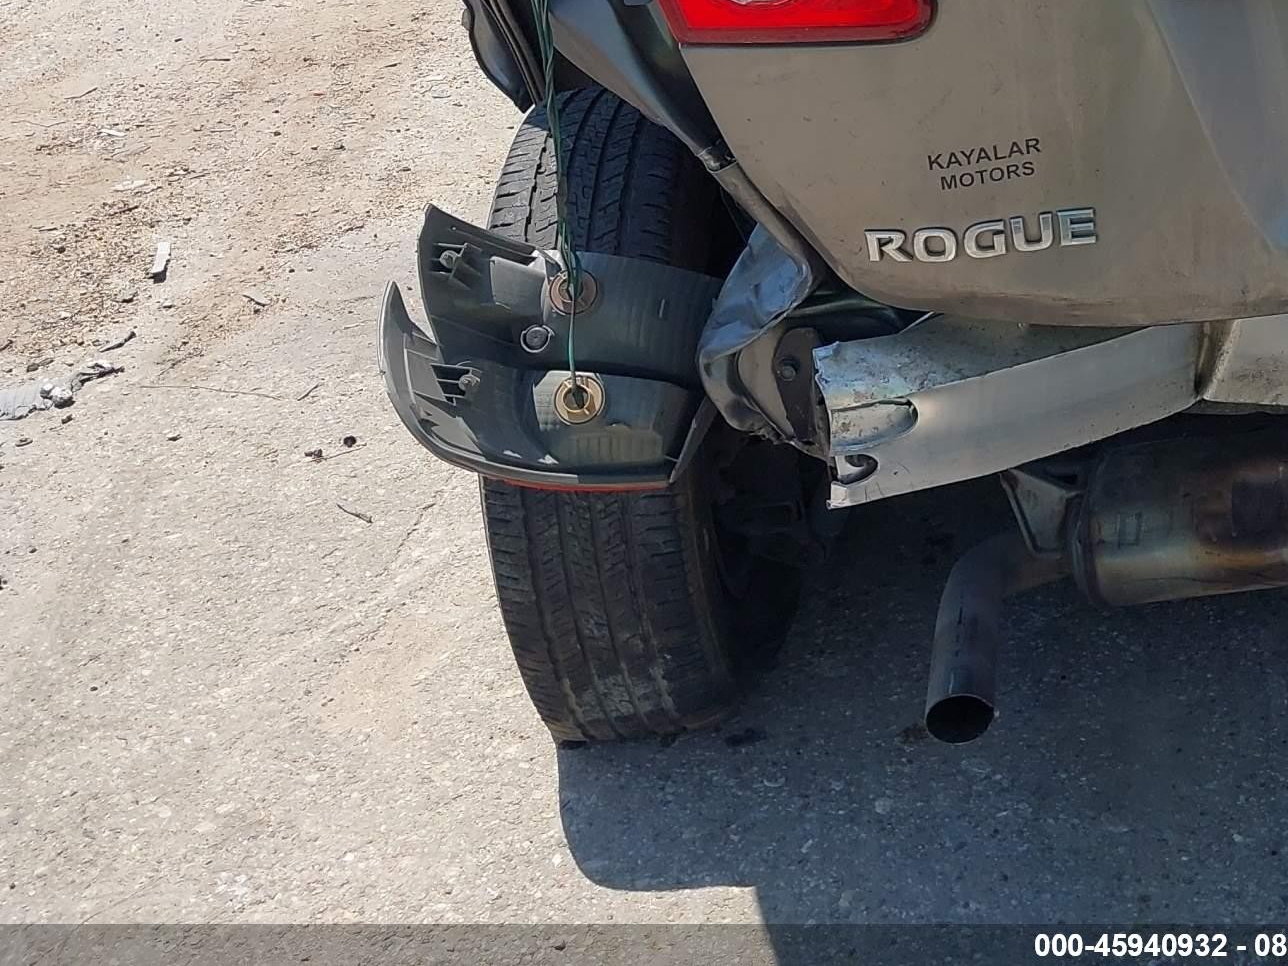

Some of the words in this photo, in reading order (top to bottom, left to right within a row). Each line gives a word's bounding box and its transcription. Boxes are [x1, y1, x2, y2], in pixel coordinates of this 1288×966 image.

[927, 137, 1043, 171] KAYALAR
[940, 161, 1036, 191] MOTORS
[864, 207, 1098, 264] ROGUE
